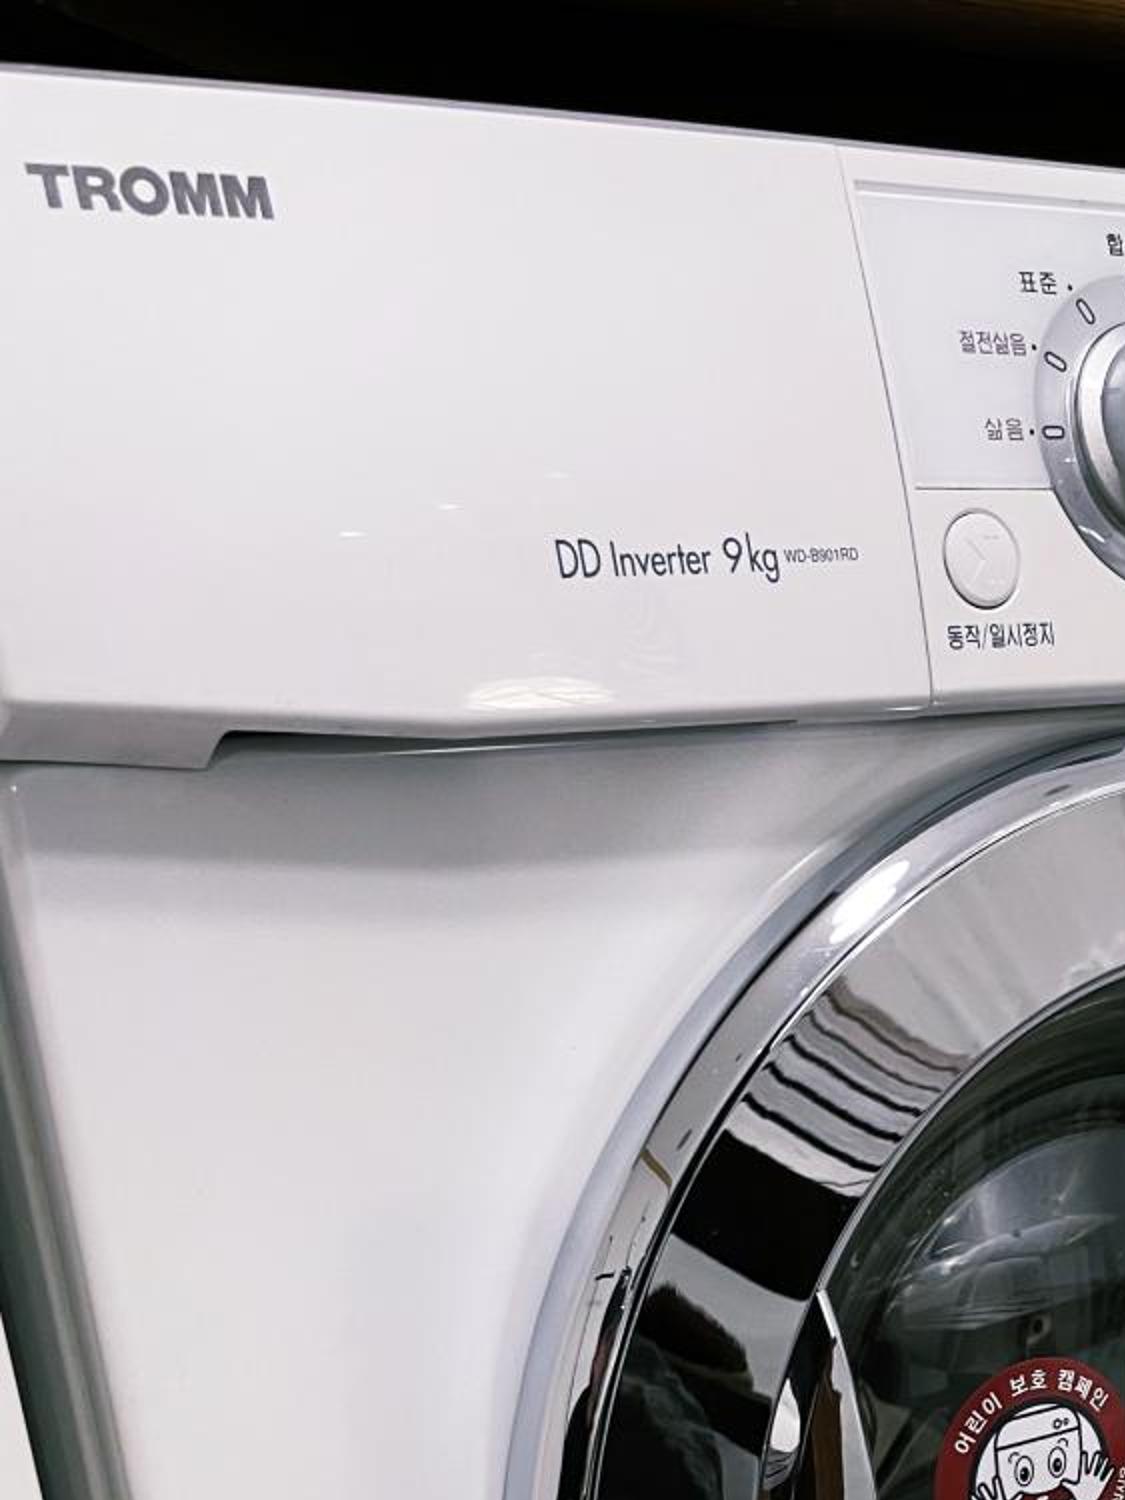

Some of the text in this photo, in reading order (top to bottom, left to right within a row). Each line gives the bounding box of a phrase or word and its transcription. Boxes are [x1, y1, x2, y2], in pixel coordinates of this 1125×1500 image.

[24, 162, 275, 220] TROMM
[1018, 271, 1057, 296] 표준
[554, 538, 602, 579] DD
[609, 540, 711, 577] Inverter
[783, 546, 859, 563] WD-B901RD
[947, 622, 1055, 651] 동작/일시정지
[954, 1369, 1109, 1454] 어린이 보호 캠페인
